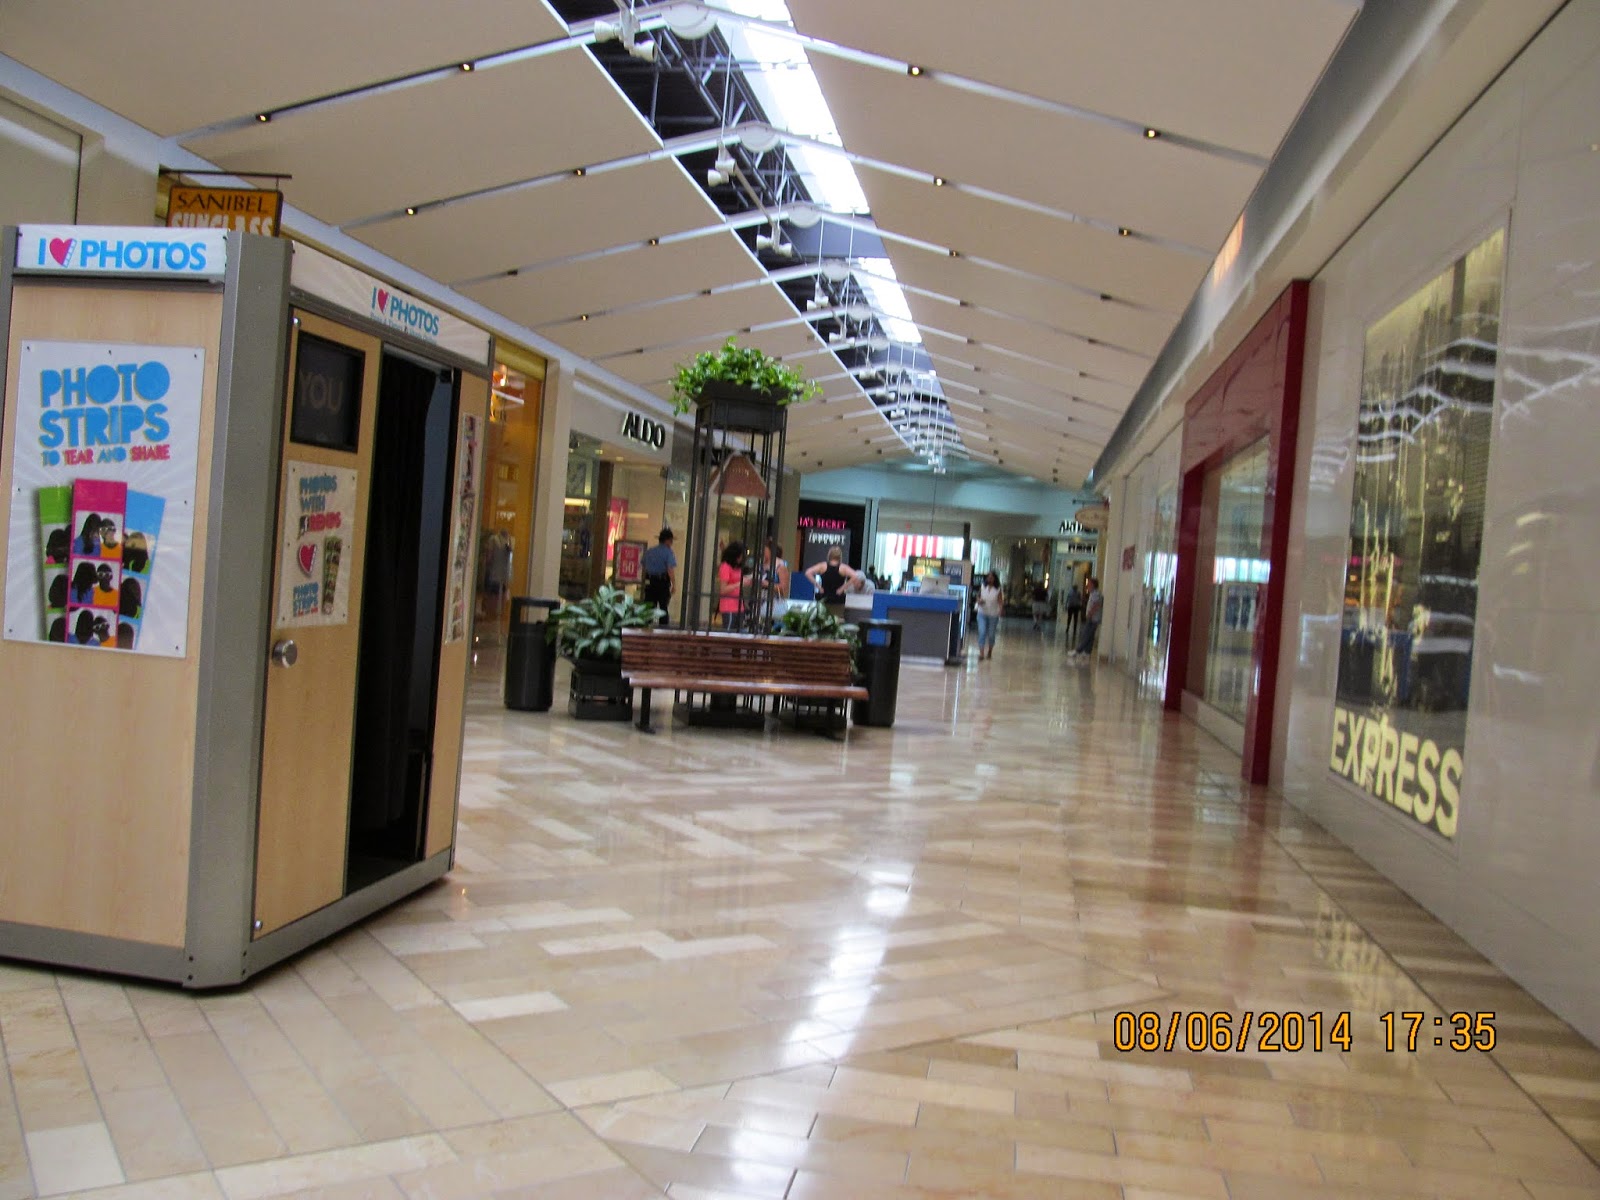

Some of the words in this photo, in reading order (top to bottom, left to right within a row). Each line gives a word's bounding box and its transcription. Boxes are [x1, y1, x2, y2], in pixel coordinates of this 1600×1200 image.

[177, 191, 269, 214] SANIBEL
[38, 237, 46, 265] I
[80, 239, 207, 270] PHOTOS
[371, 286, 378, 310] I
[390, 295, 440, 336] PHOTOS
[40, 359, 171, 408] PHOTO
[299, 367, 344, 416] YOU
[39, 403, 171, 448] STRIPS
[621, 411, 666, 451] ALDO
[42, 449, 61, 467] TO
[64, 448, 95, 466] TEAR
[98, 447, 127, 464] AND
[131, 444, 171, 462] SHARE
[816, 517, 848, 530] SECRET
[1329, 706, 1464, 840] EXPRESS
